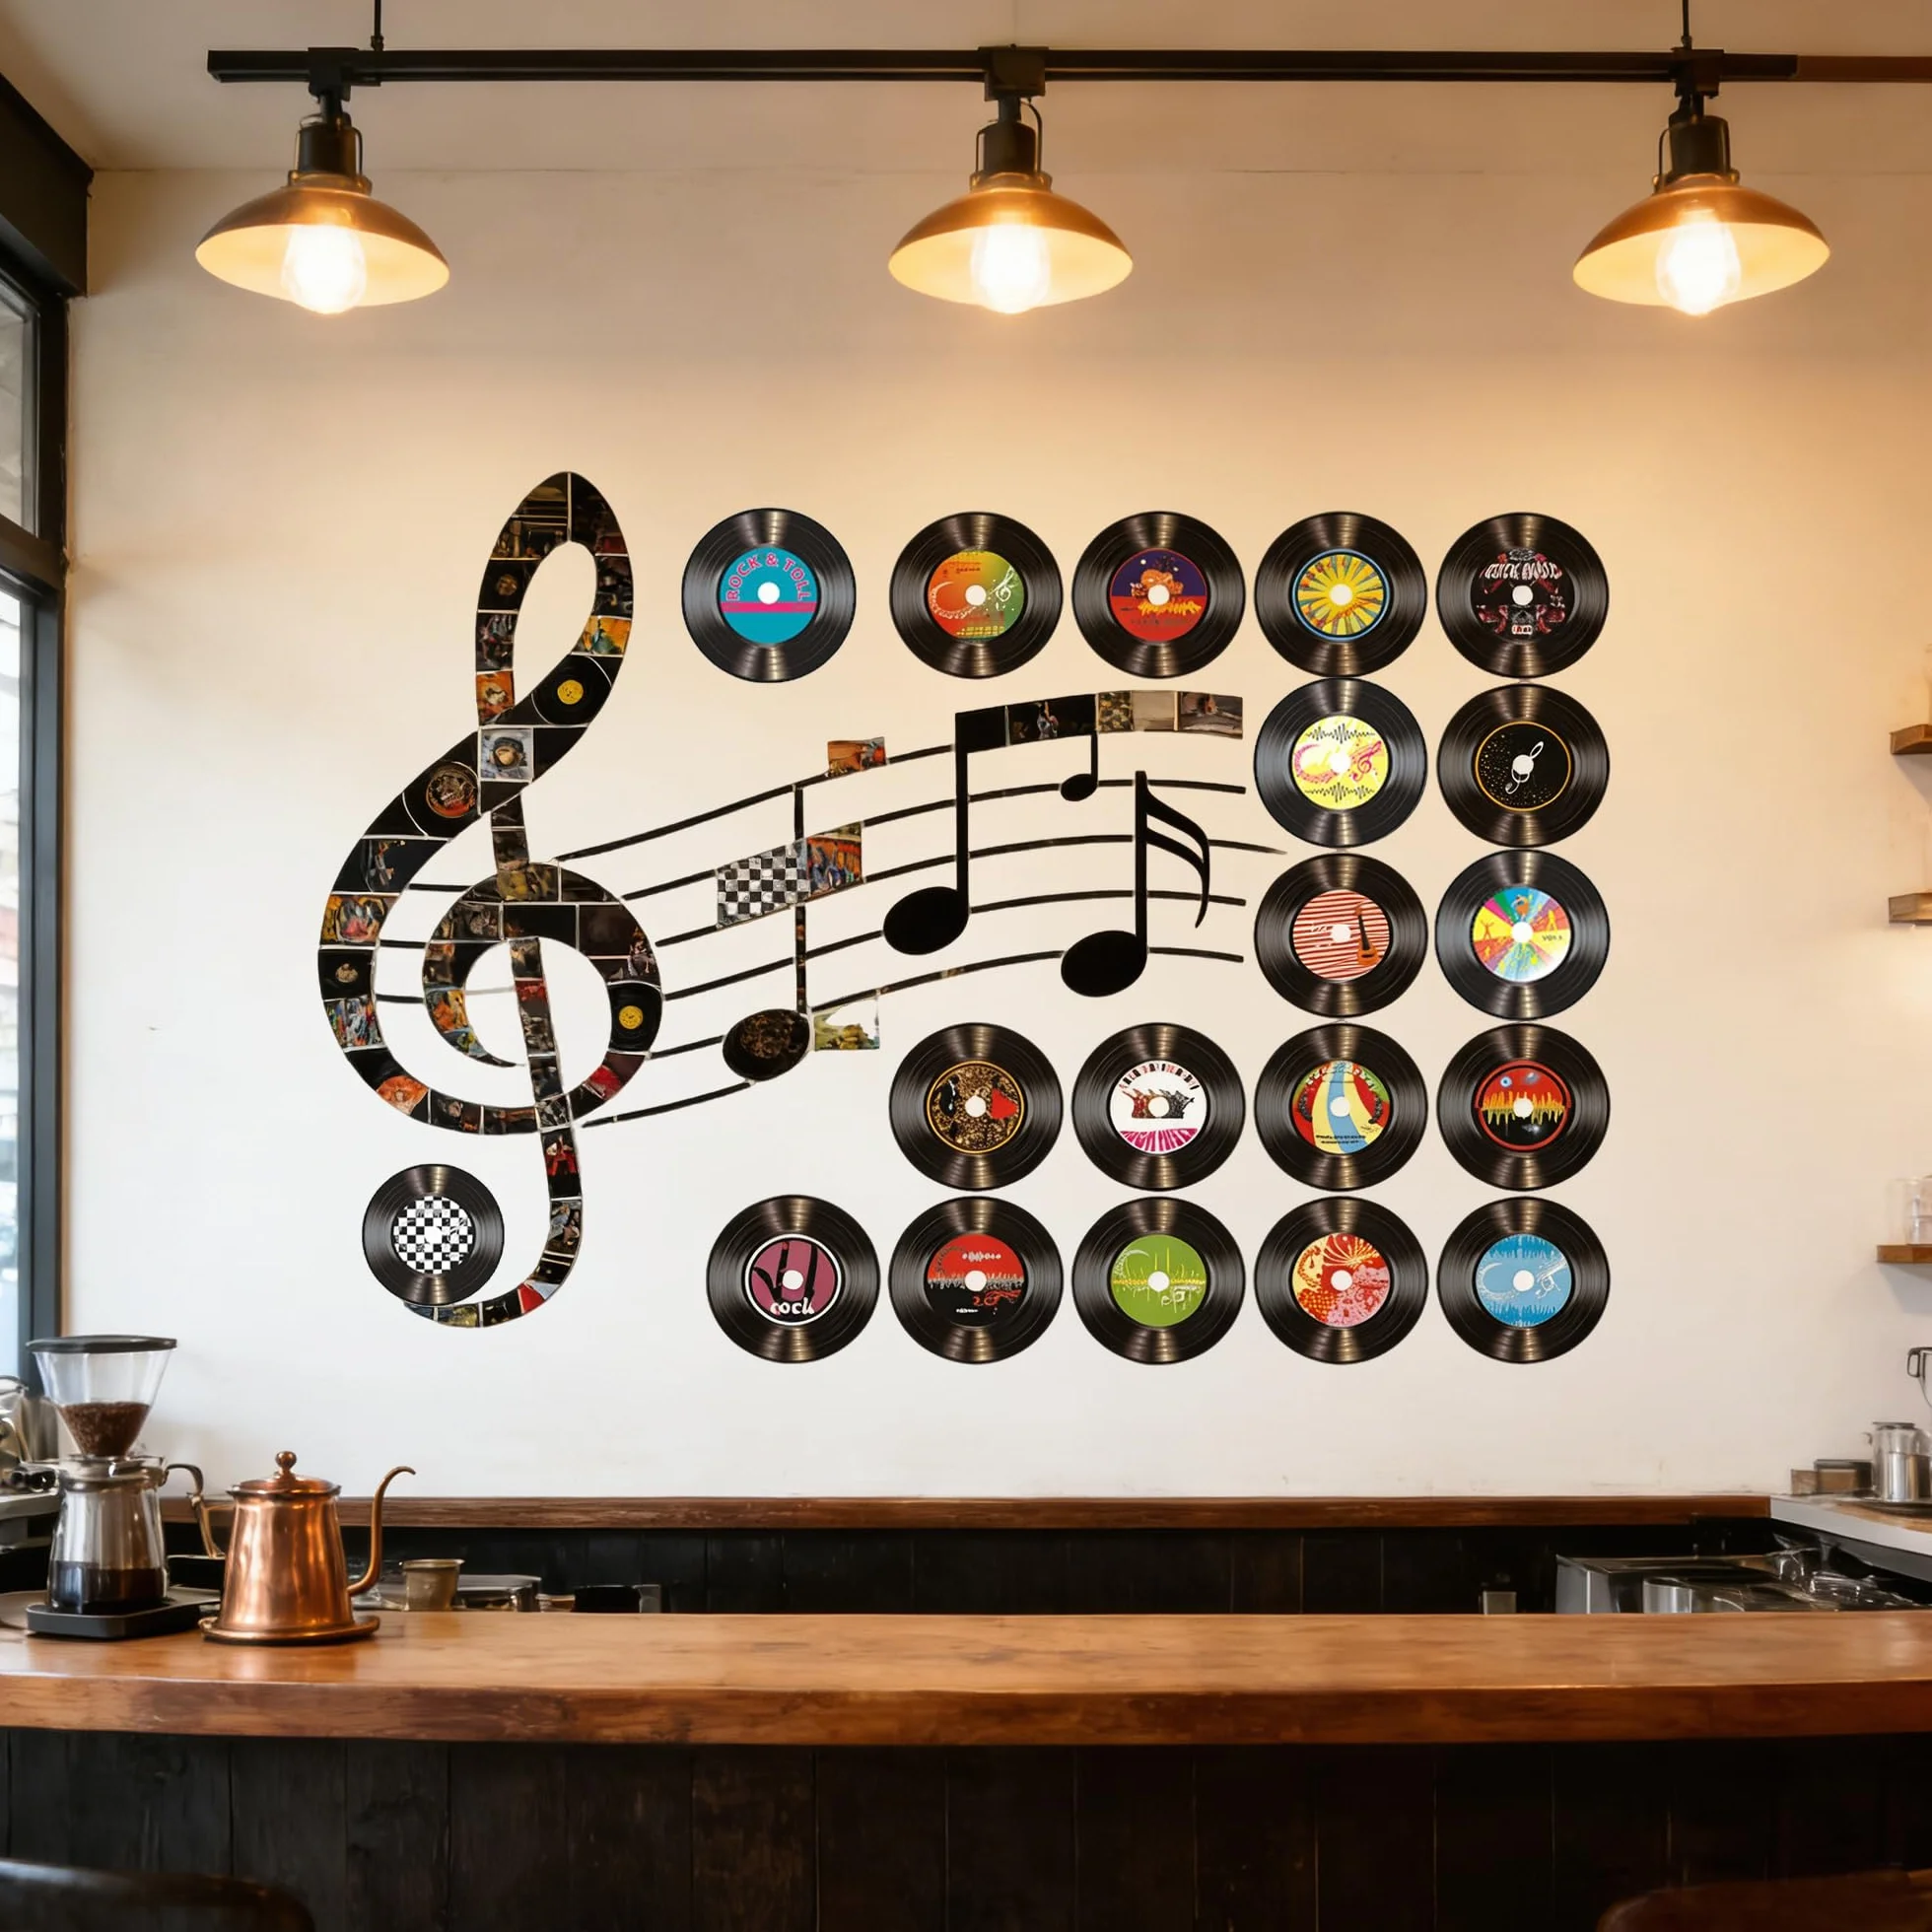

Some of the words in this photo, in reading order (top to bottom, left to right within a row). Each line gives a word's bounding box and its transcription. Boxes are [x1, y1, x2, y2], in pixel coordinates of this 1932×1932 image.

[726, 554, 762, 601] ROCK
[766, 552, 779, 567] &
[783, 558, 811, 601] TOLL
